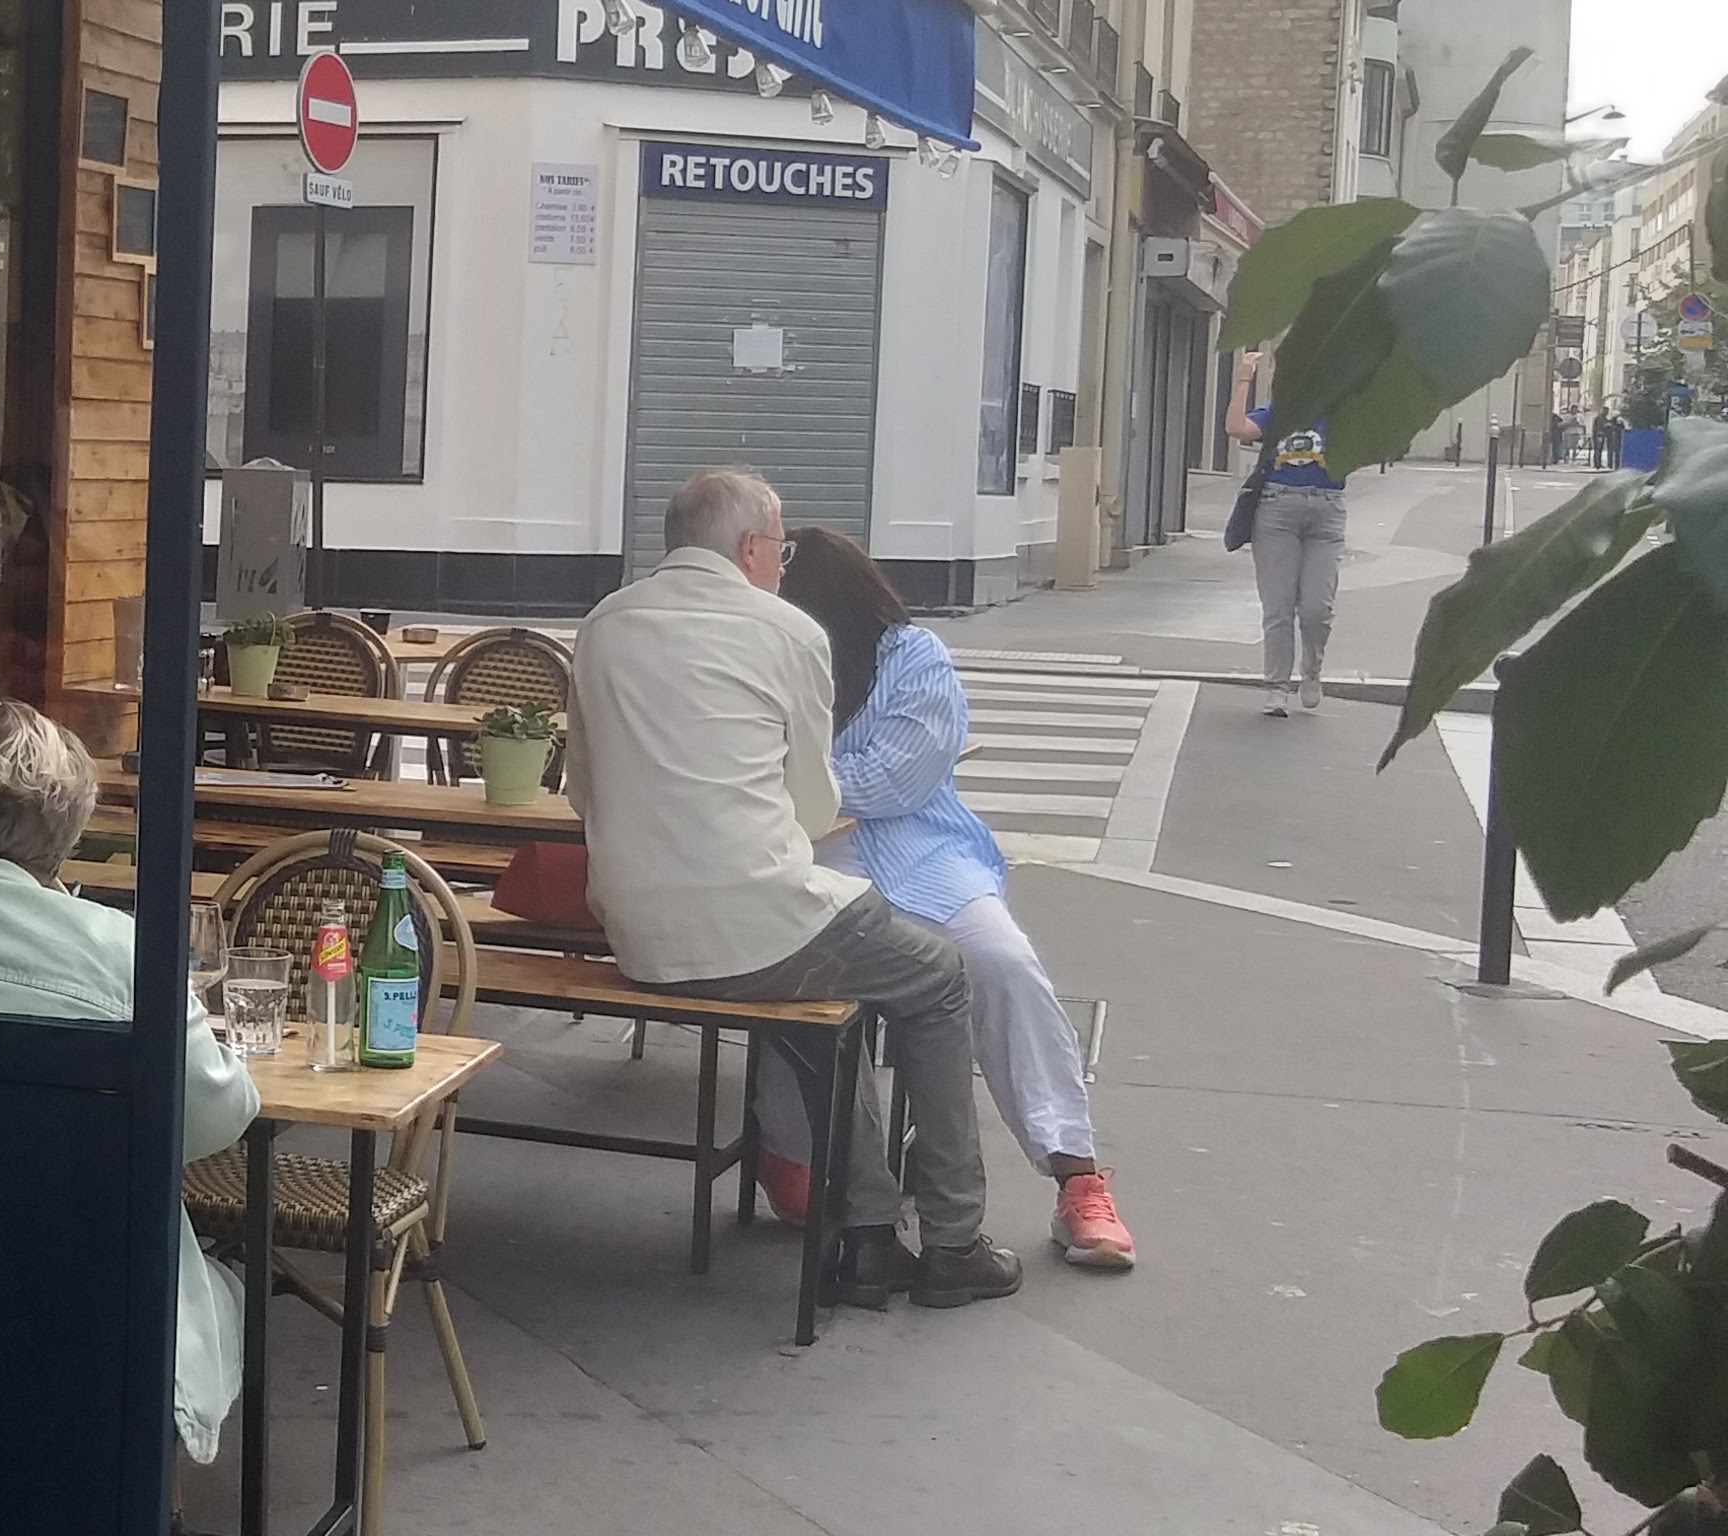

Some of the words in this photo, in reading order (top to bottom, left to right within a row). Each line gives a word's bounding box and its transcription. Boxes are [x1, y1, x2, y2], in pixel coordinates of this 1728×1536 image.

[219, 0, 340, 57] RIE
[308, 181, 330, 197] SAUF
[539, 174, 555, 185] NOS
[658, 154, 876, 202] RETOUCHES
